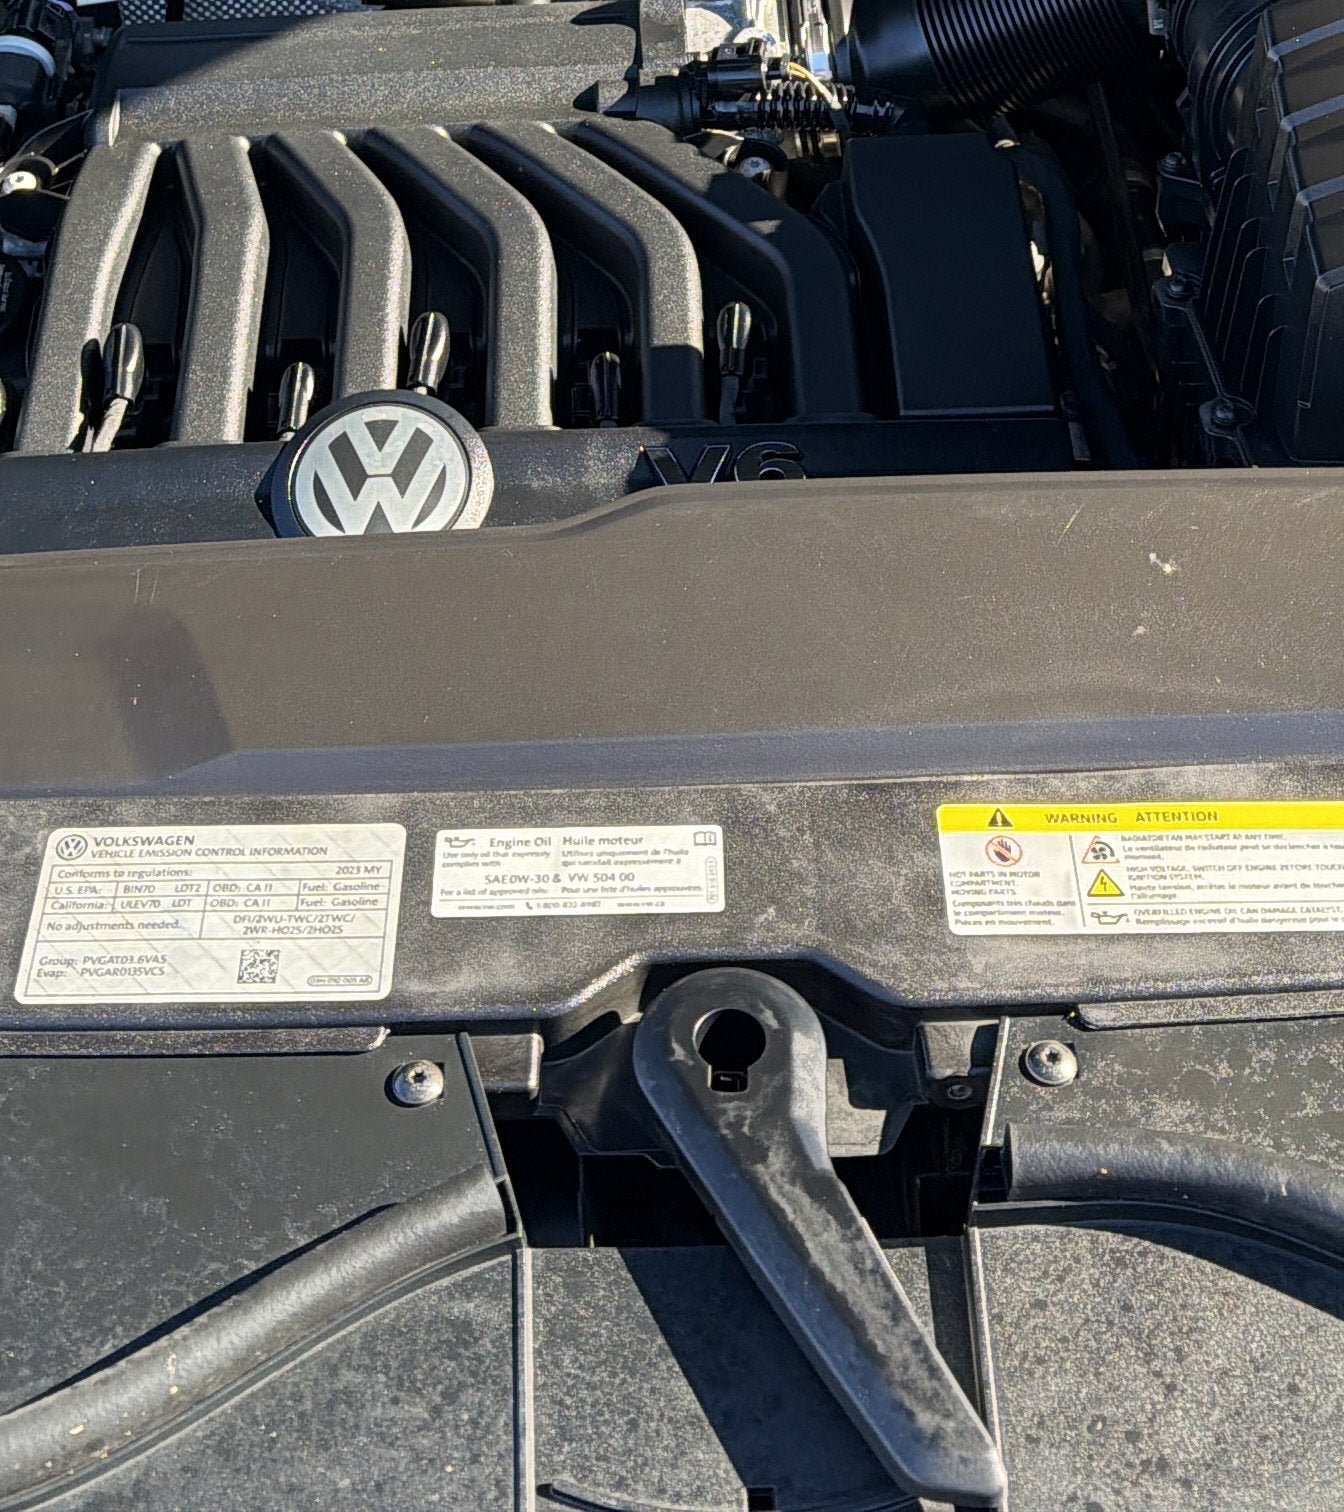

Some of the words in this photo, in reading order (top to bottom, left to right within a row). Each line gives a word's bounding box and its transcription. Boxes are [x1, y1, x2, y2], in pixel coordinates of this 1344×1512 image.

[1044, 812, 1118, 824] WARNING
[1135, 810, 1218, 823] ATTENTION
[93, 835, 196, 847] VOLKSWAGEN
[490, 837, 531, 850] Engine
[534, 836, 552, 847] Oil
[562, 836, 595, 846] Huile
[598, 836, 644, 846] moteur
[91, 849, 135, 858] VEHICLE
[139, 848, 193, 858] EMISSION
[195, 847, 246, 857] CONTROL
[249, 846, 328, 856] INFORMATION
[57, 868, 110, 879] Conforms
[113, 869, 125, 878] to
[127, 867, 194, 879] regulations:
[335, 866, 360, 875] 2023
[364, 865, 382, 874] MY
[552, 873, 562, 884] &
[568, 873, 589, 883] VW
[593, 873, 616, 882] 504
[618, 872, 635, 882] 00
[123, 884, 156, 893] BIN70
[246, 883, 262, 892] CA
[302, 882, 328, 891] Fuel:
[333, 882, 380, 892] Gasoline
[50, 900, 108, 910] California:
[120, 899, 161, 909] ULEV70
[171, 899, 193, 908] LDT
[243, 898, 259, 907] CA
[300, 898, 327, 907] Fuel:
[331, 897, 379, 907] Gasoline
[46, 921, 63, 931] No
[65, 920, 134, 933] adjustments
[39, 956, 79, 968] Group:
[36, 968, 67, 979] Evap:
